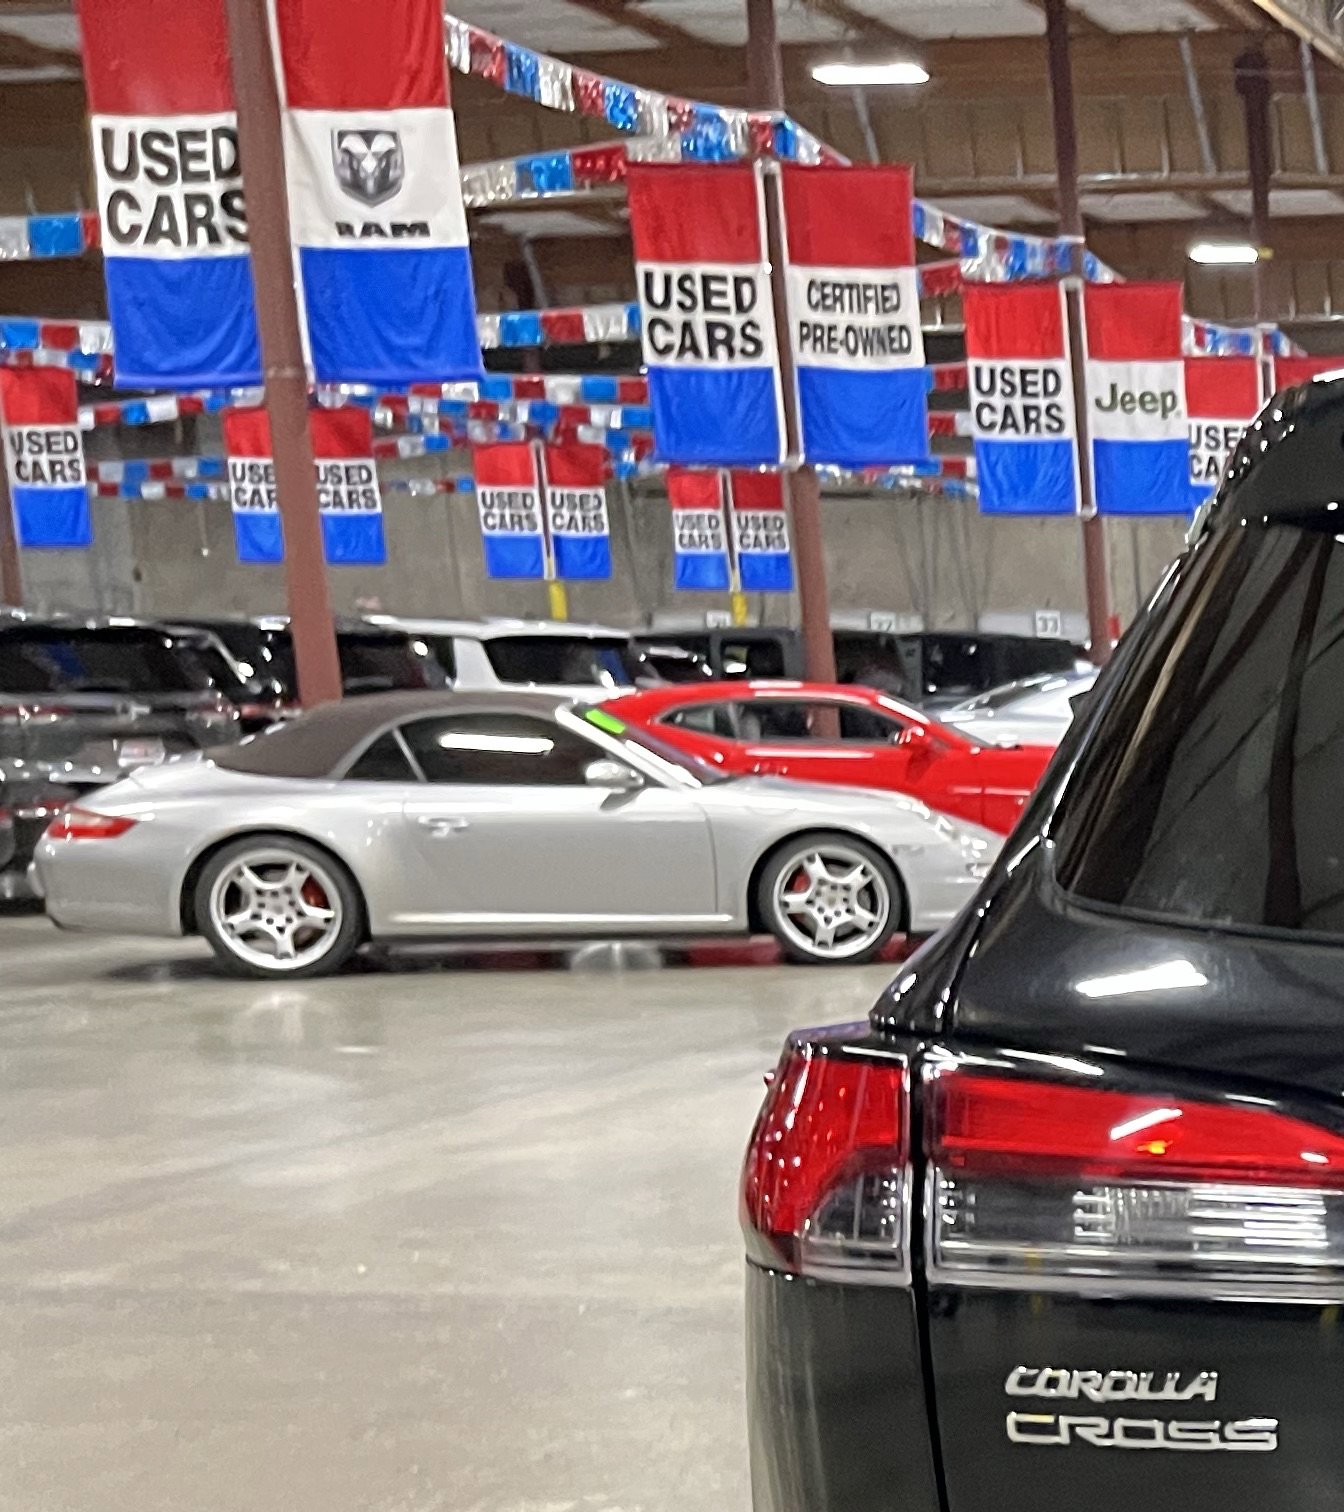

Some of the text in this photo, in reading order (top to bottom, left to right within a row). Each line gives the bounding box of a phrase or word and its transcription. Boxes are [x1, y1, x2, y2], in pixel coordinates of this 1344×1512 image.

[101, 127, 242, 185] USED
[106, 189, 249, 247] CARS
[335, 221, 430, 238] RAM
[644, 271, 757, 314] USED
[807, 279, 900, 315] CERTIFIED
[648, 317, 763, 361] CARS
[800, 321, 912, 357] PRE-OWNED
[974, 366, 1062, 399] USED
[1095, 383, 1177, 419] Jeep
[975, 402, 1066, 435] CARS
[11, 430, 78, 456] USED
[1189, 424, 1247, 451] USE
[15, 459, 82, 483] CARS
[232, 463, 274, 484] USE
[317, 464, 372, 487] USED
[318, 486, 378, 510] CARS
[481, 491, 534, 510] USED
[551, 492, 601, 511] USED
[483, 511, 538, 532] CARS
[552, 512, 605, 532] CARS
[737, 515, 784, 532] USED
[739, 533, 786, 550] CARS
[1005, 1366, 1217, 1402] COROLLA
[1007, 1411, 1279, 1450] CROSS
